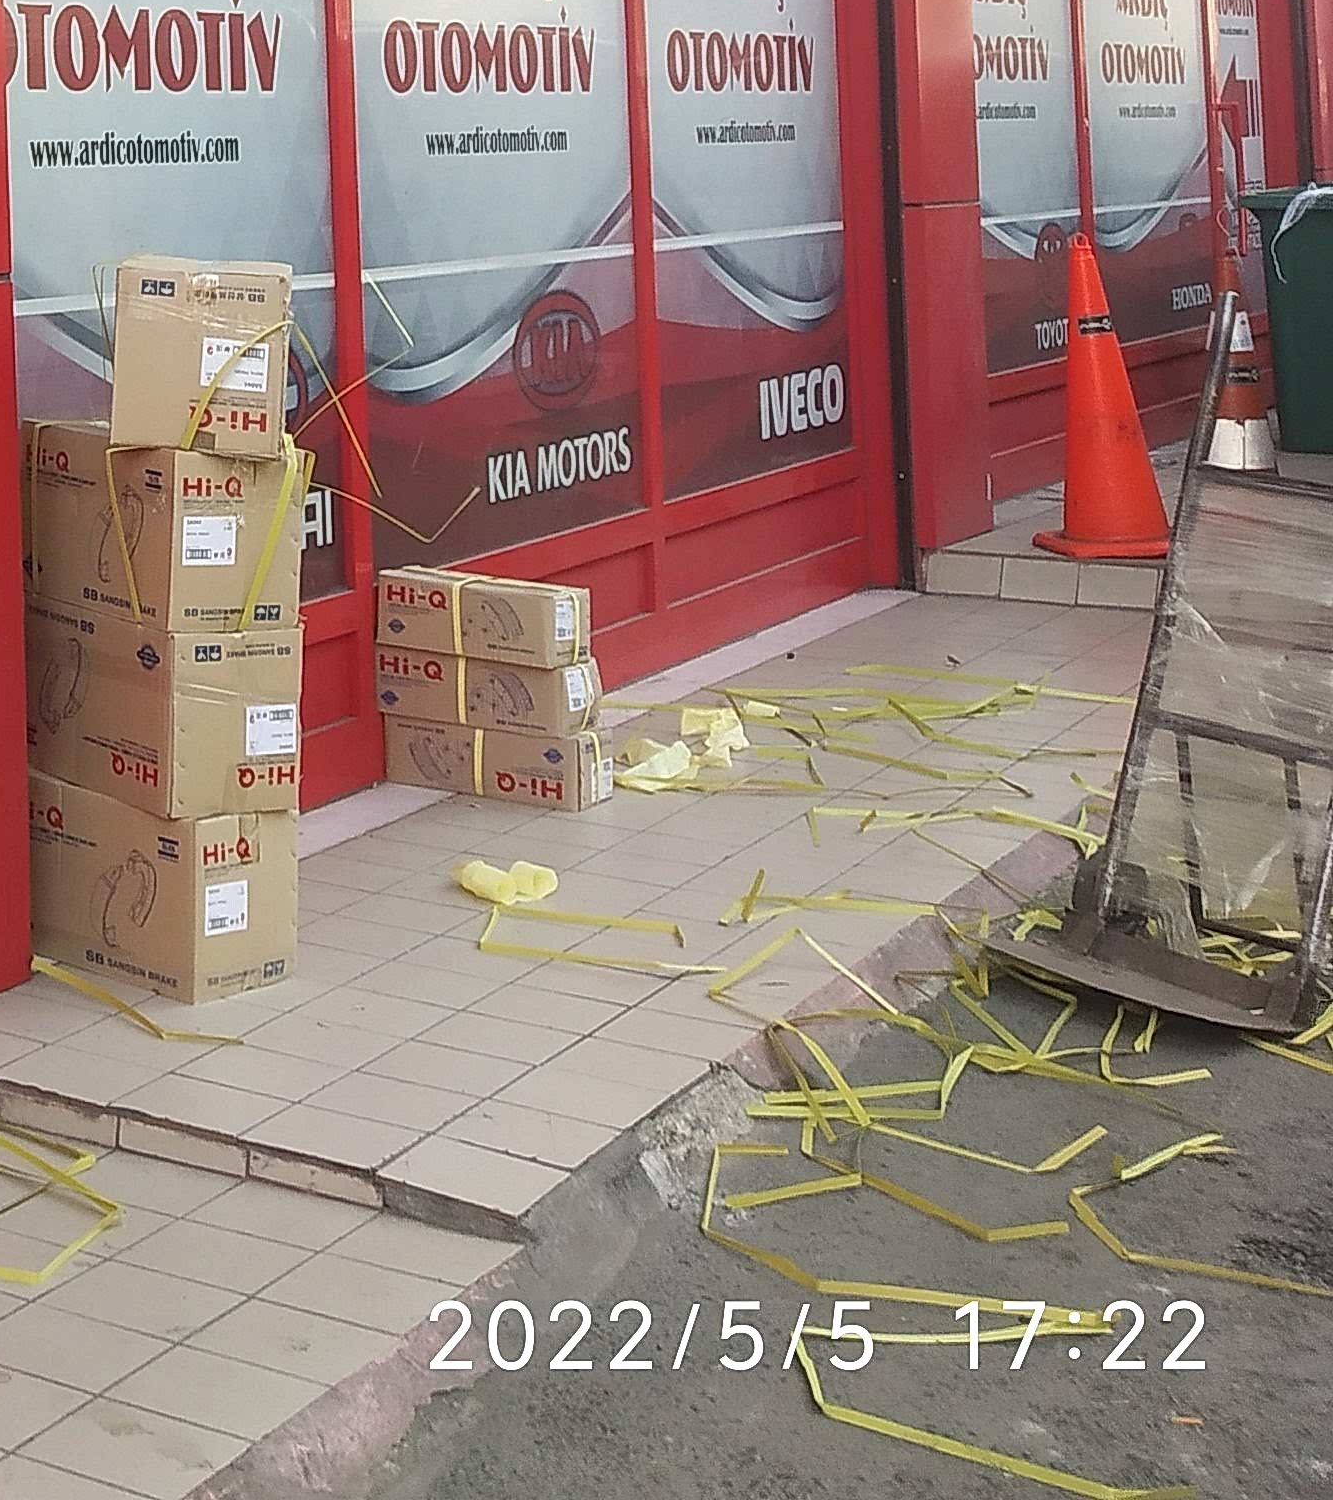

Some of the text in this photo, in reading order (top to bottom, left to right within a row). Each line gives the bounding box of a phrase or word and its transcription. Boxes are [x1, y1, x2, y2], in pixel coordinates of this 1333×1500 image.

[383, 6, 595, 94] OTOMOTİV
[667, 18, 814, 93] OTOMOTİV
[1102, 36, 1186, 85] OTOMOTİV
[30, 130, 240, 168] www.ardicotomotiv.com
[426, 124, 569, 158] www.ardicotomotiv.com
[695, 121, 797, 145] www.ardicotomotiv.com
[1171, 283, 1213, 311] HONDA
[759, 364, 845, 440] IVECO
[487, 426, 632, 503] KIA MOTORS
[182, 477, 244, 499] Hi-Q
[386, 584, 449, 611] Hi-Q
[378, 653, 444, 682] Hi-Q
[111, 752, 159, 789] Hi-Q
[238, 764, 296, 789] Hi-Q
[495, 771, 564, 801] Hi-Q
[202, 836, 252, 866] Hi-Q
[85, 949, 179, 988] SB SANGSIN BRAKE
